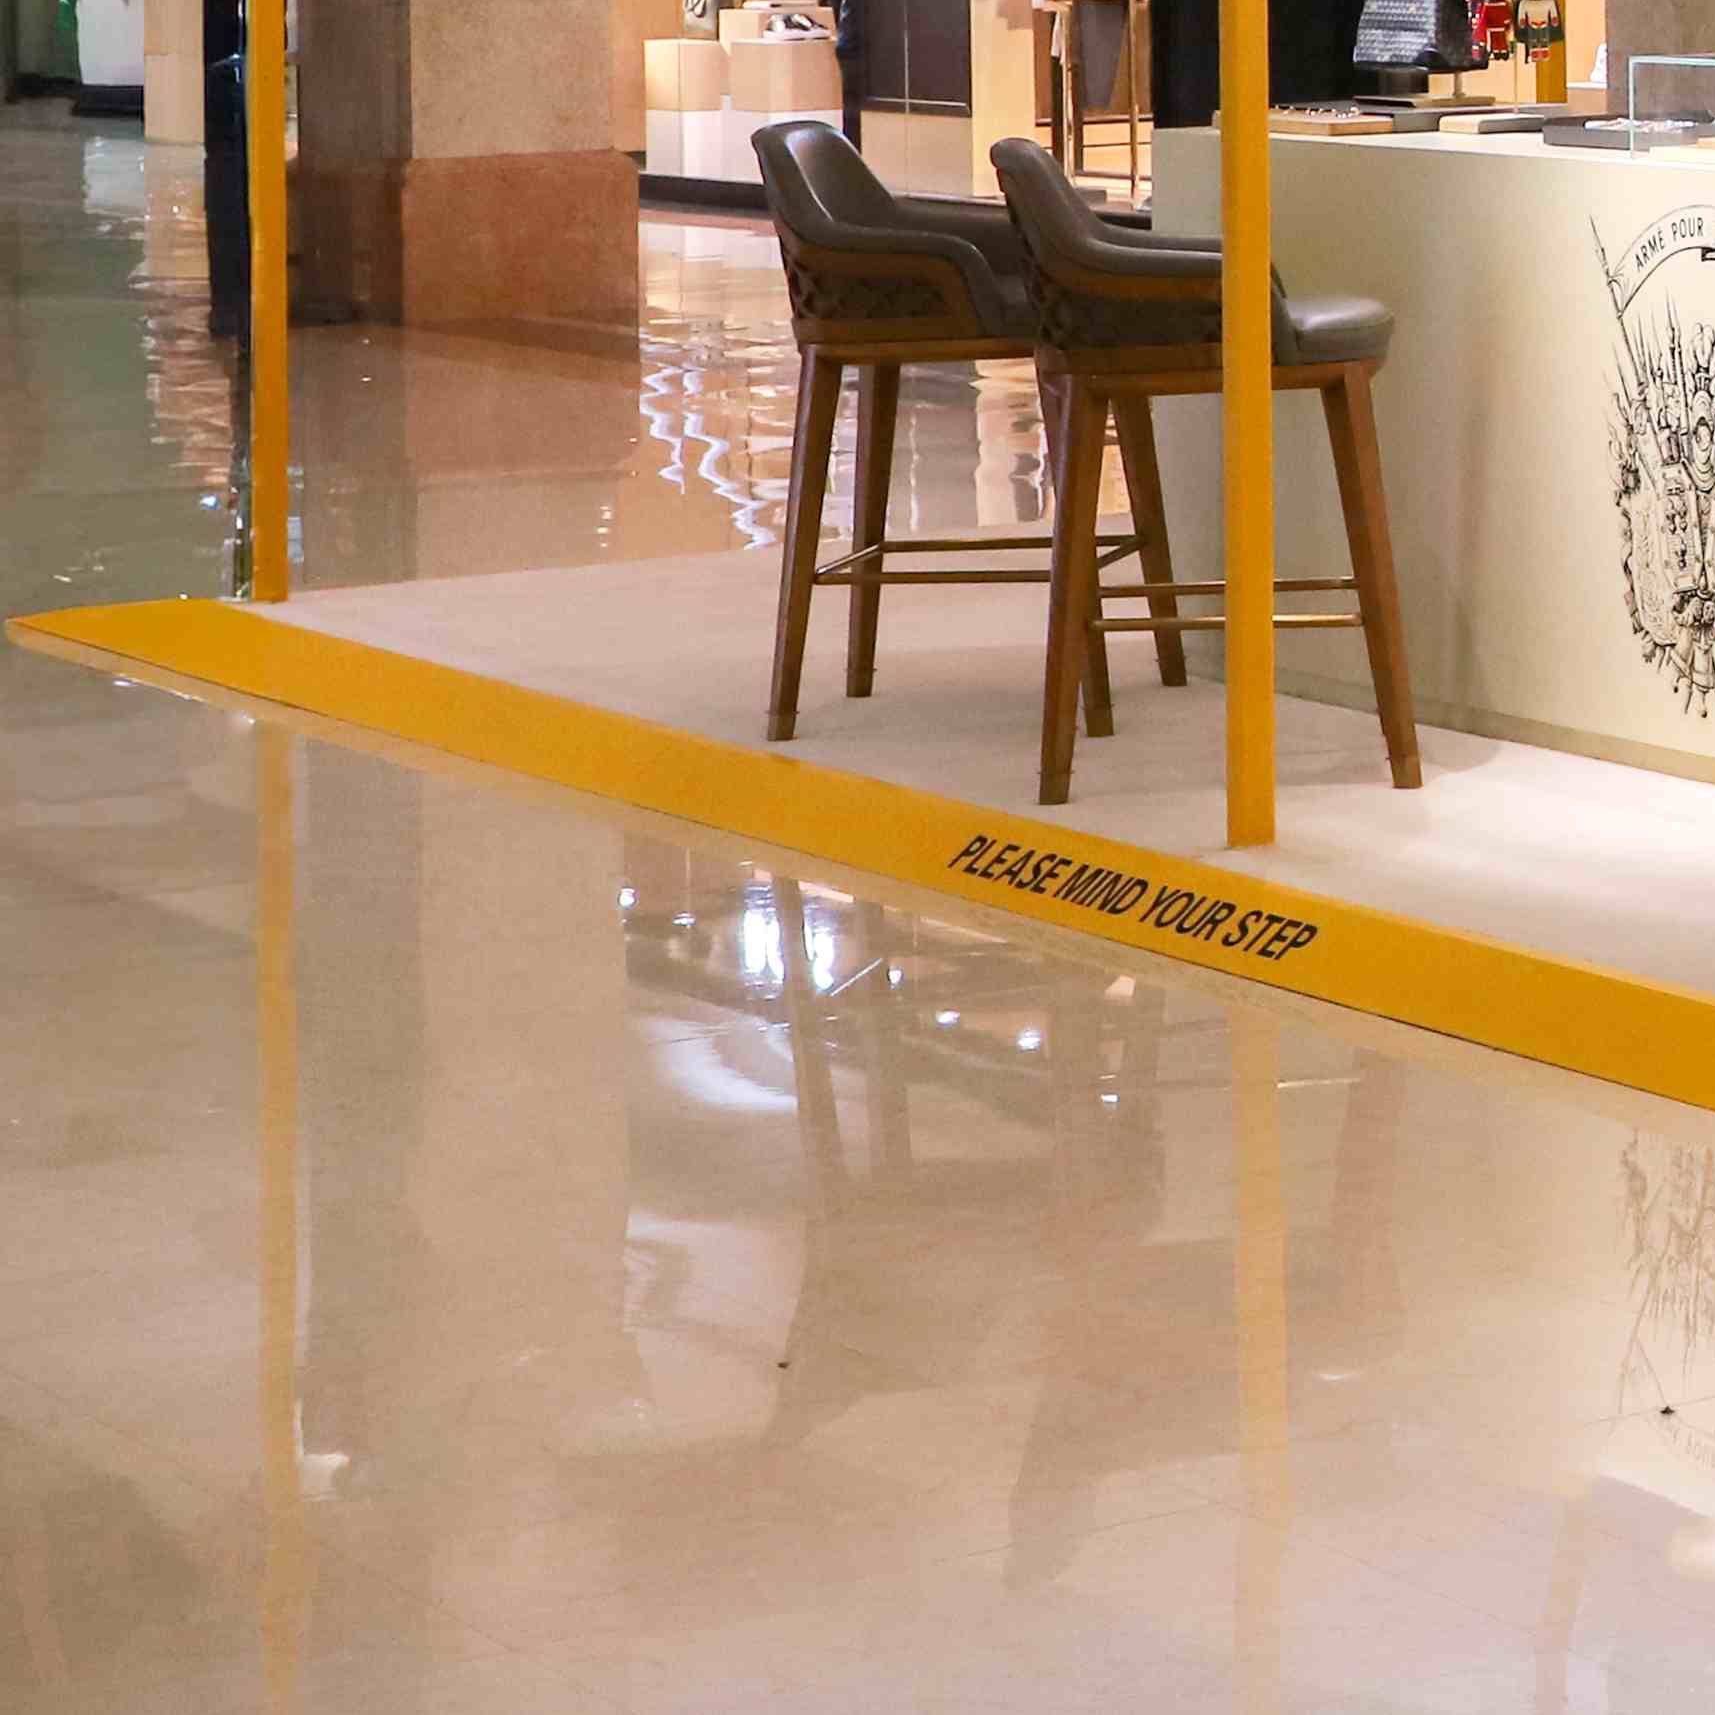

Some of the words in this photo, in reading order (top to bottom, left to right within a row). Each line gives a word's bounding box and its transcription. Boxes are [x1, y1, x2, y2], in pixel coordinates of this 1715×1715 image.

[1671, 217, 1704, 242] POUR
[948, 836, 1072, 894] PLEASE
[1053, 865, 1148, 914] MIND
[1139, 886, 1236, 940] YOUR
[1222, 910, 1317, 960] STEP
